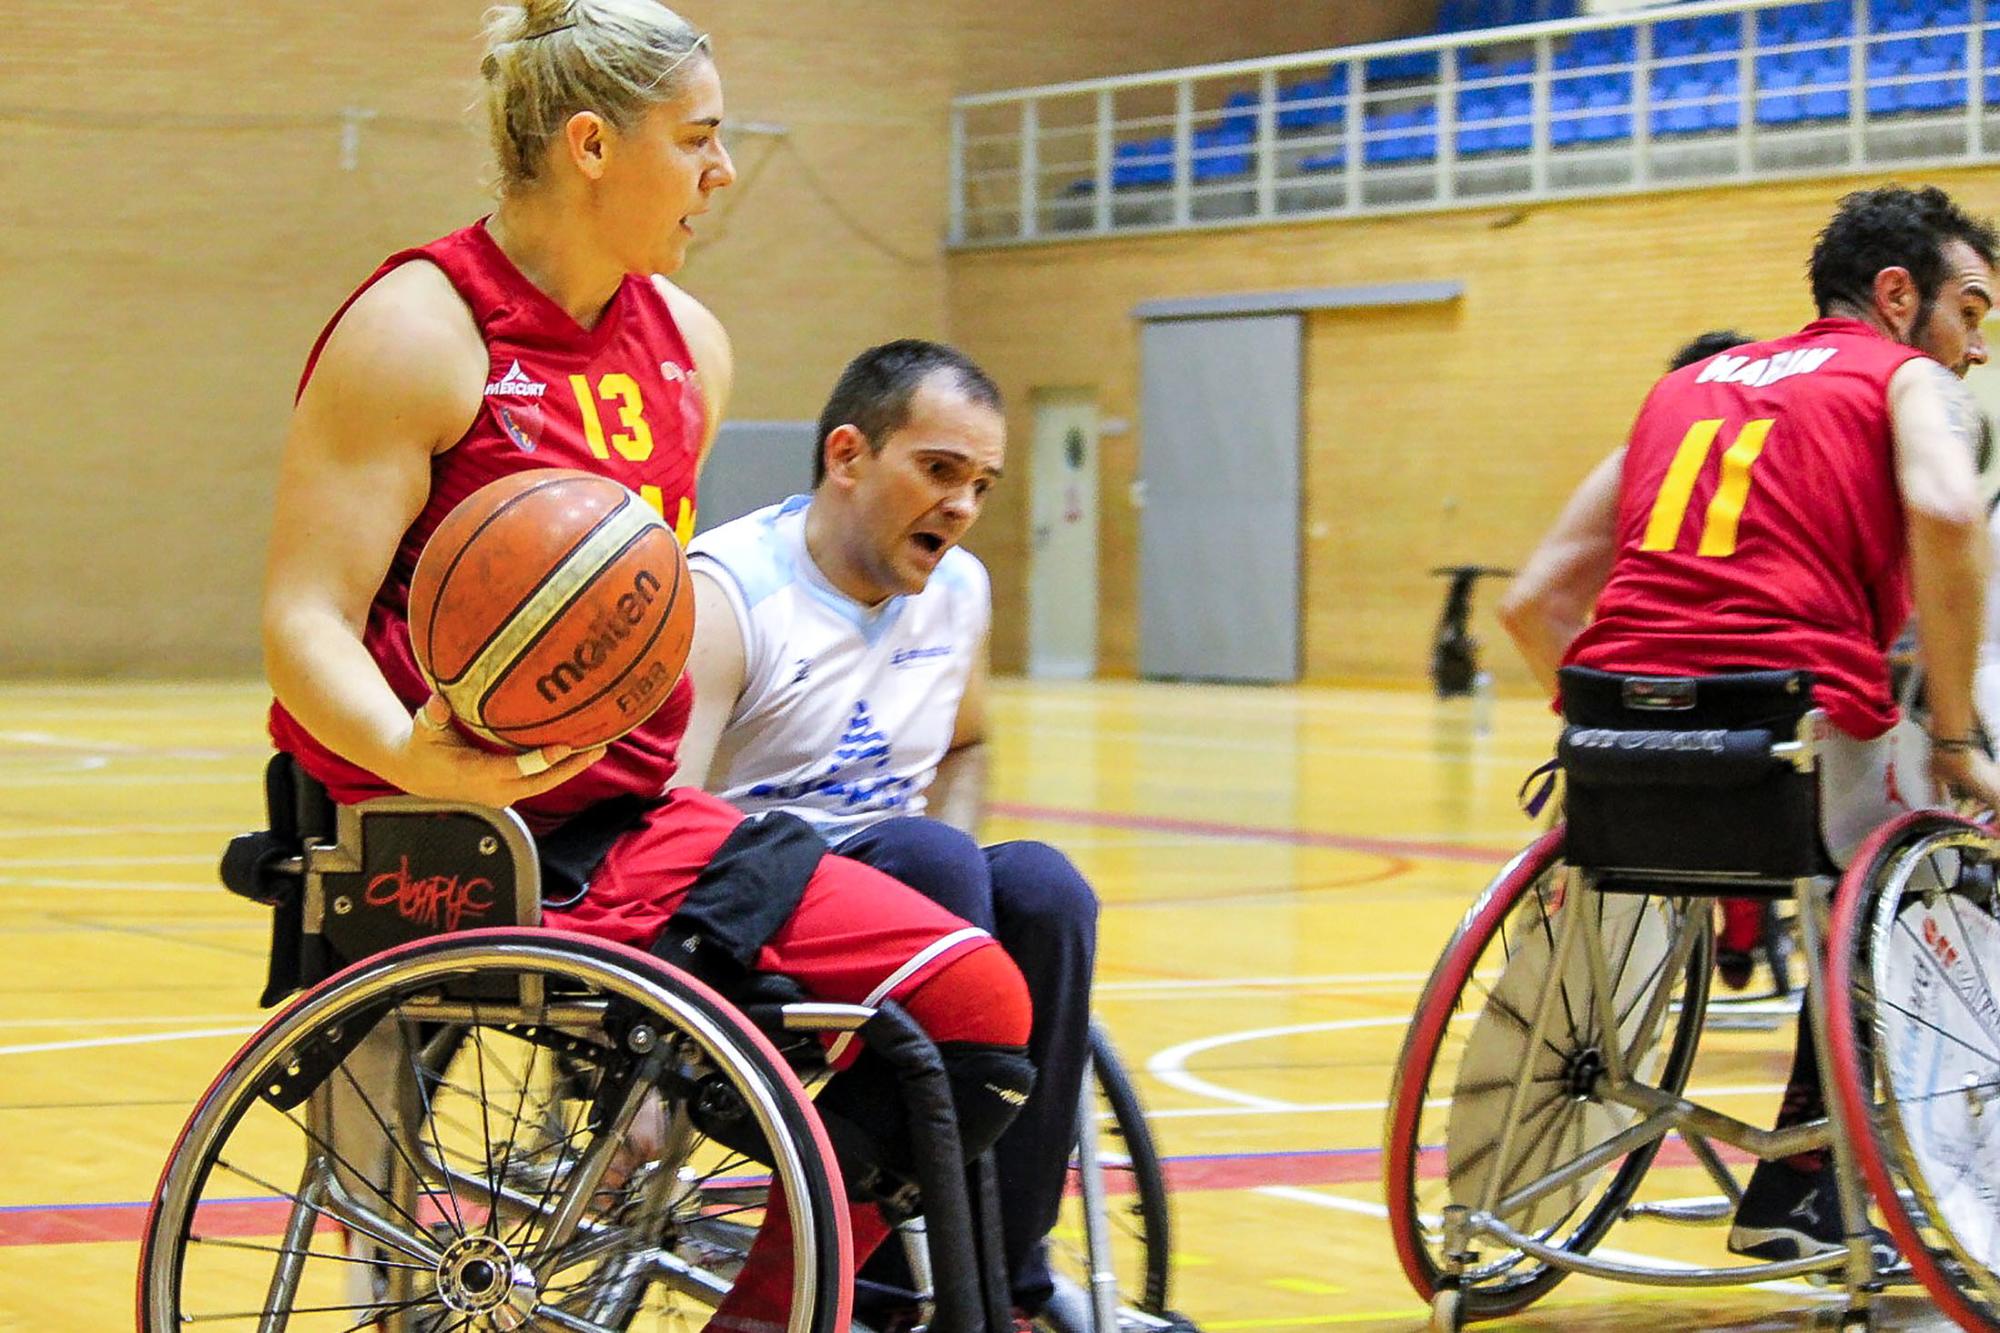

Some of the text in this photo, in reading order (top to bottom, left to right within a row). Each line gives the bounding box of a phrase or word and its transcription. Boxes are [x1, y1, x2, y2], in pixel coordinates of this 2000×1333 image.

[484, 381, 548, 397] MERCURY
[568, 372, 654, 461] 13
[1638, 417, 1777, 558] 11
[535, 569, 661, 704] molten
